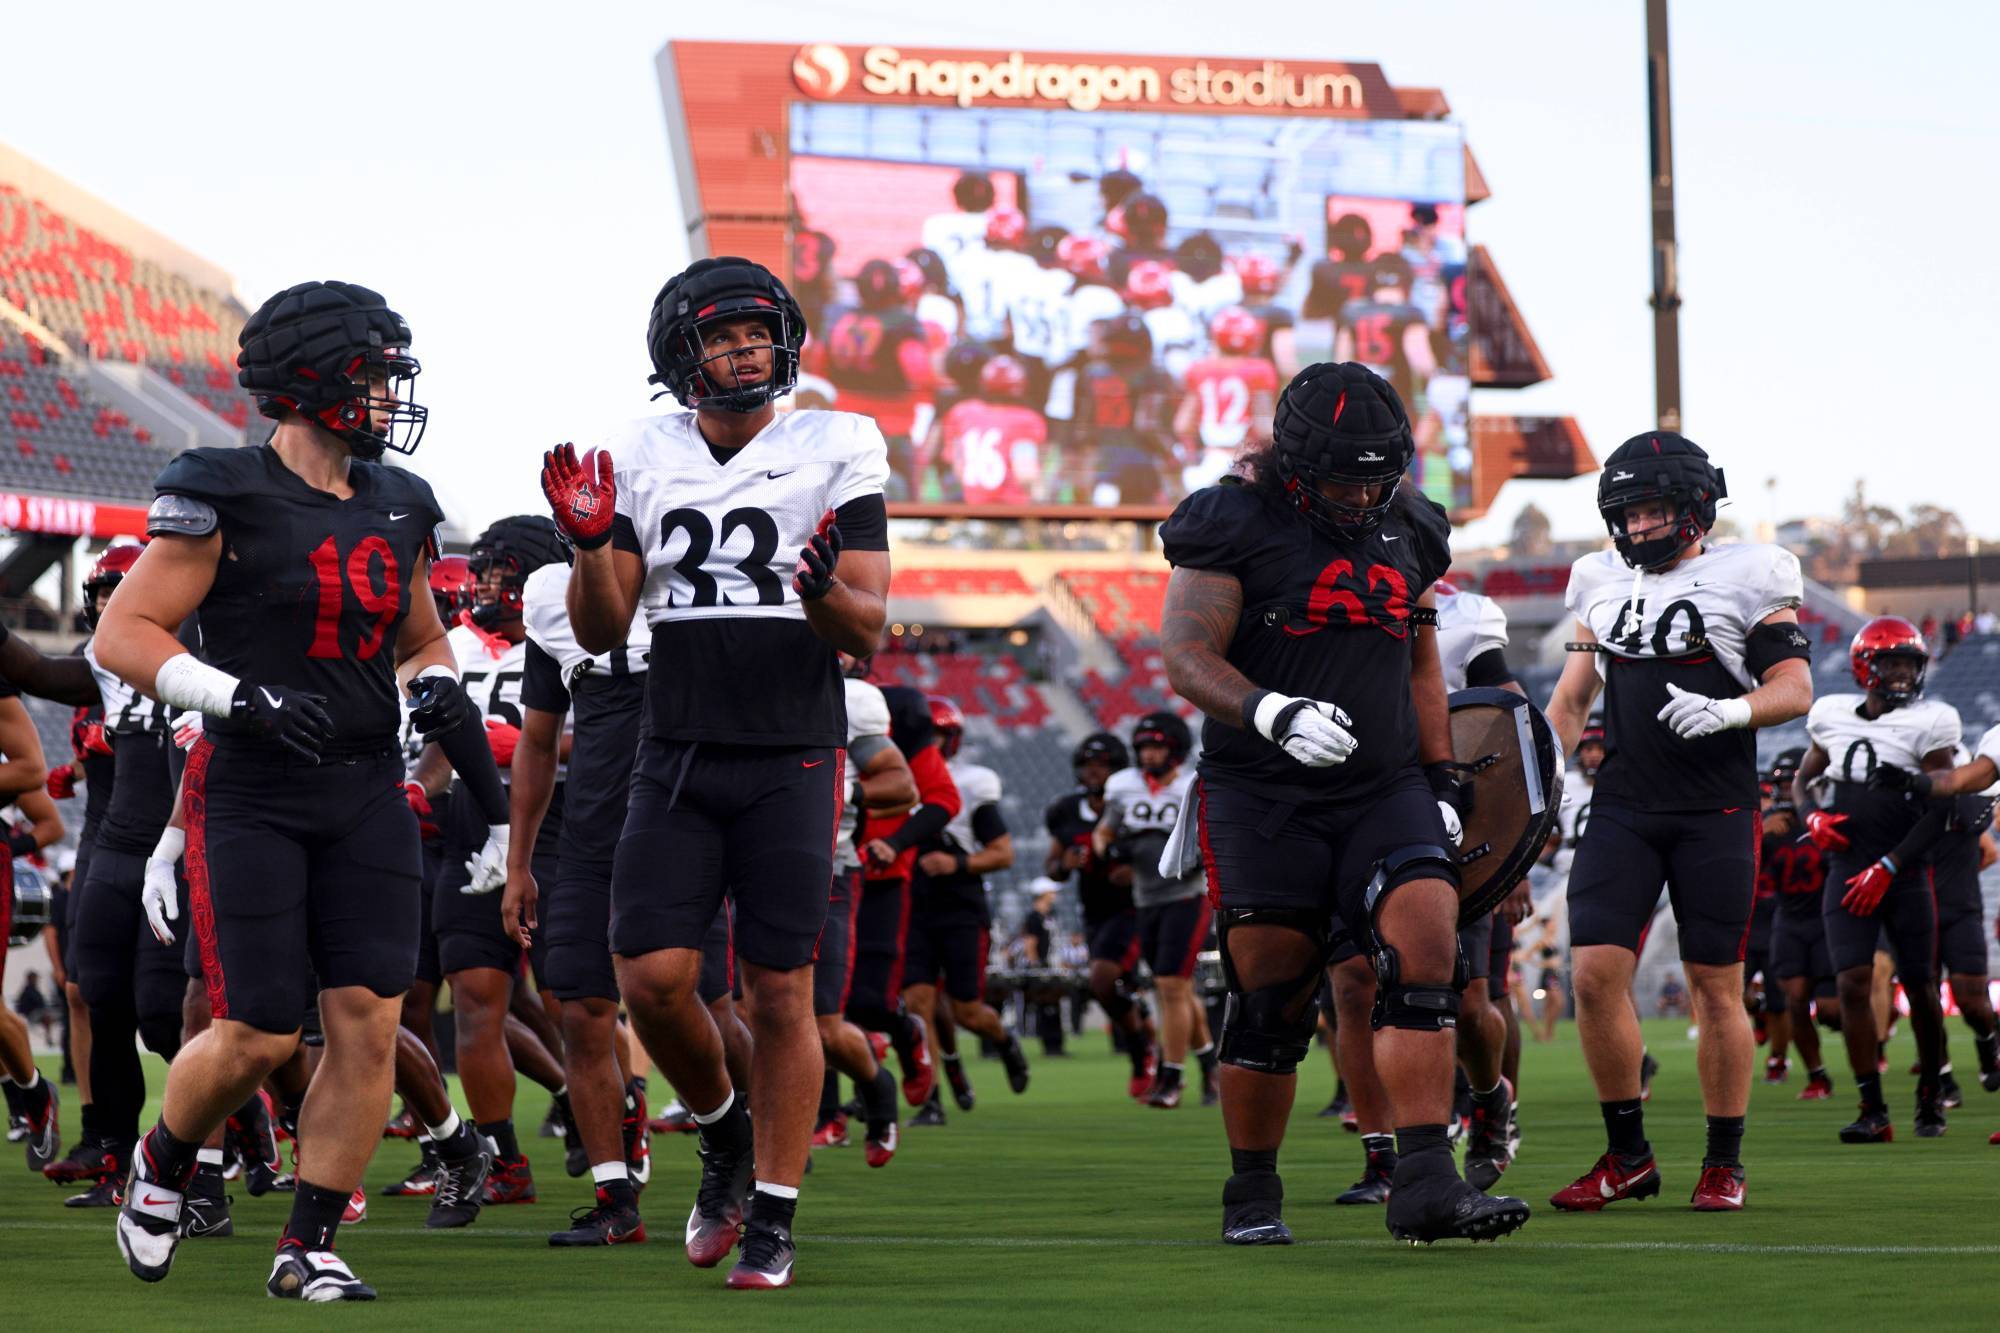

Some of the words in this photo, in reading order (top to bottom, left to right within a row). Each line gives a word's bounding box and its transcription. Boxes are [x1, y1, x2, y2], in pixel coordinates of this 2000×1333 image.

[863, 45, 1160, 112] Snapdragon
[1170, 60, 1363, 109] stadium
[1200, 375, 1249, 438] 12
[963, 428, 1006, 490] 16
[660, 506, 785, 608] 33
[305, 534, 400, 660] 19
[1308, 558, 1409, 624] 63
[1606, 598, 1706, 656] 40
